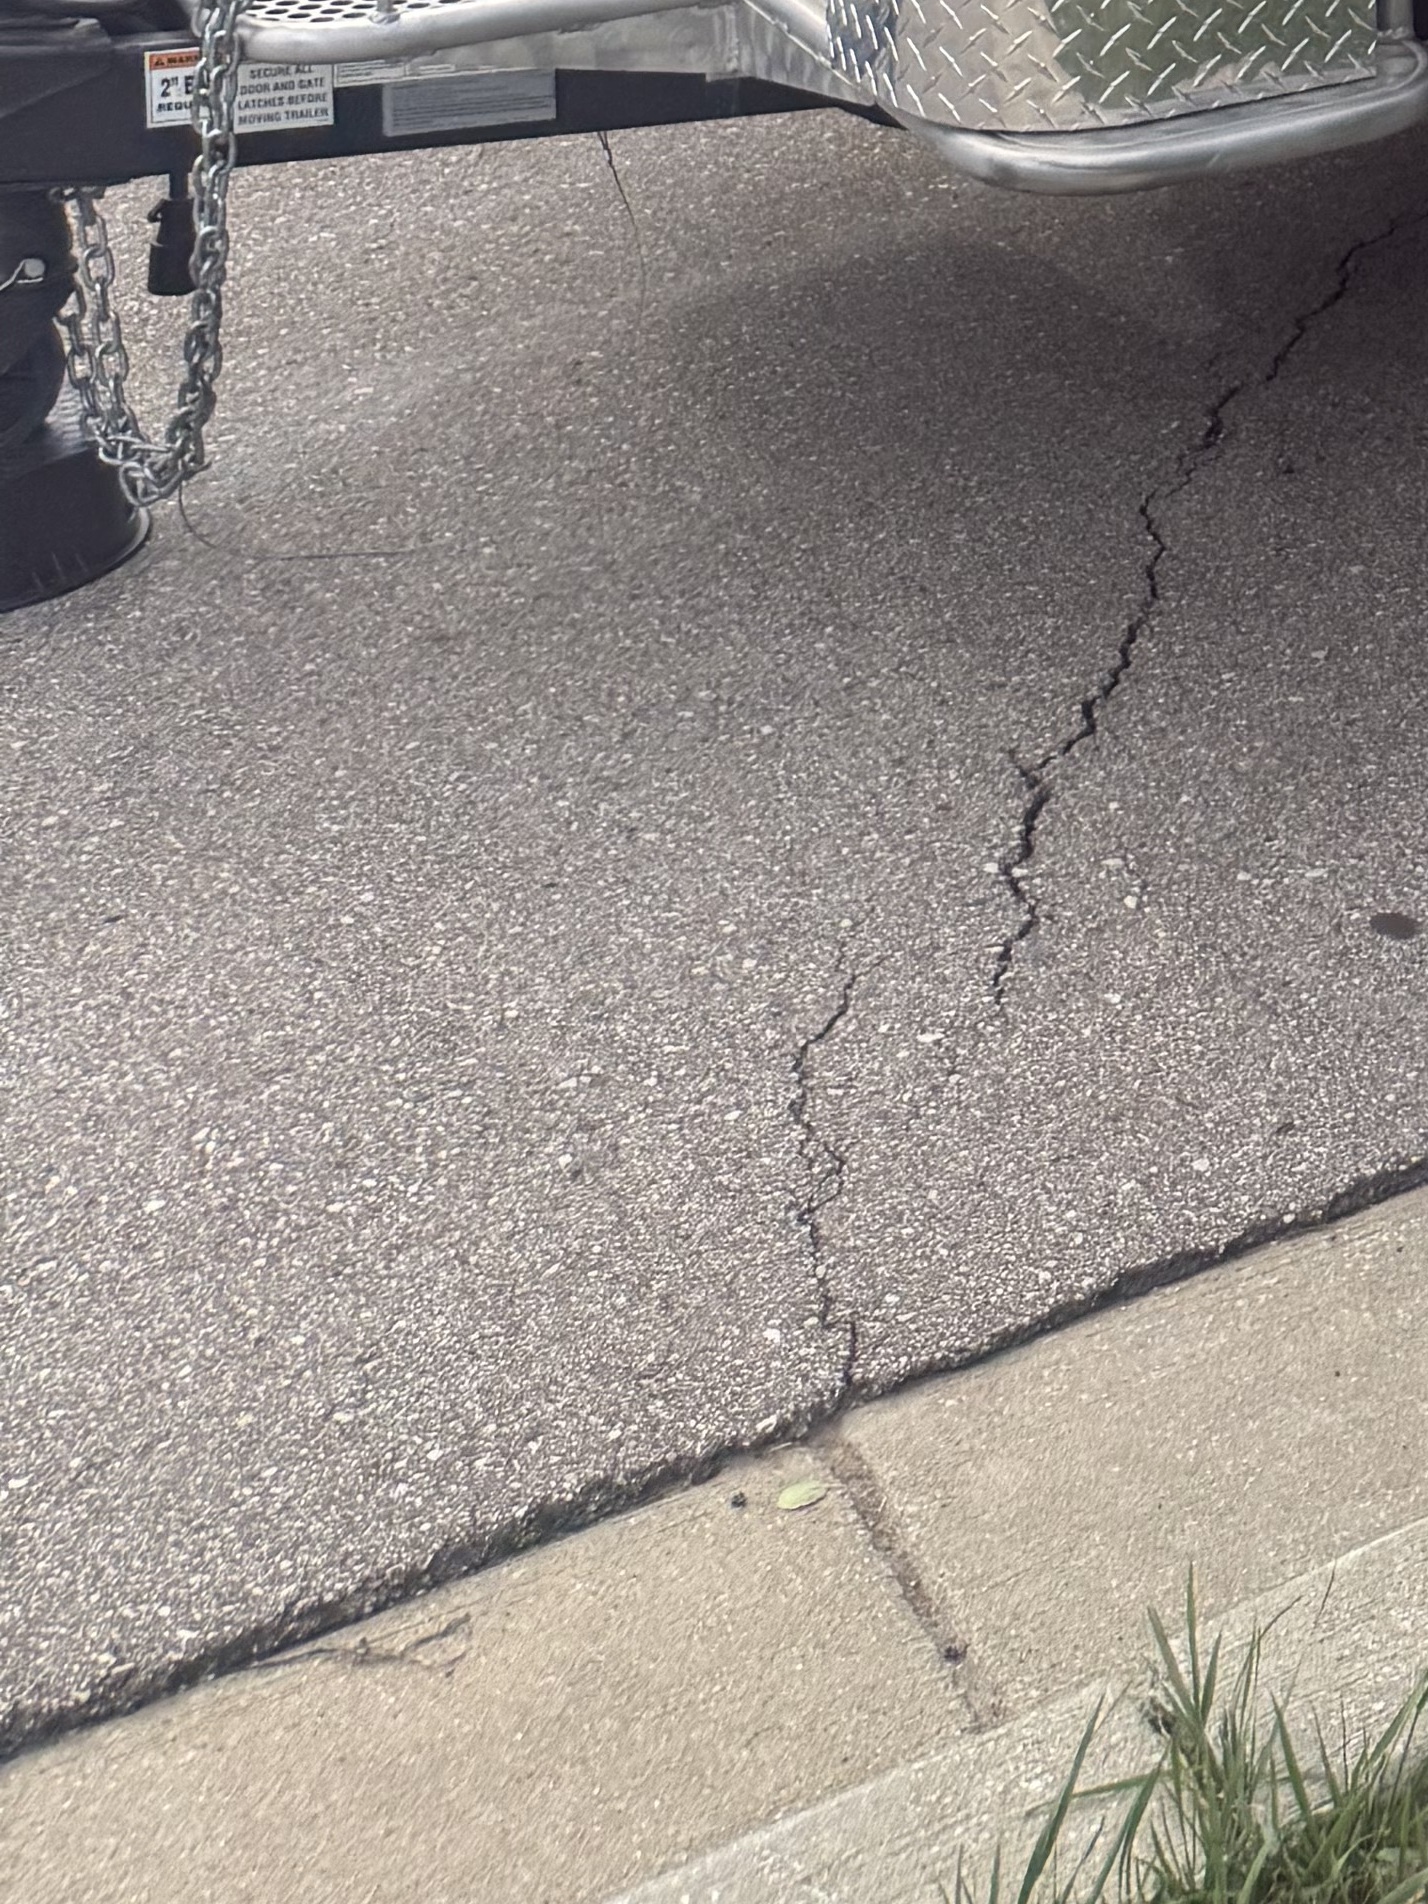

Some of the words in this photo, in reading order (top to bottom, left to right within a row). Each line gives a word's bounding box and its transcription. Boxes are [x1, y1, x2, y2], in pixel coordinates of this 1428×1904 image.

[250, 65, 292, 79] SECURE
[294, 64, 314, 74] ALL
[240, 83, 271, 96] DOOR
[273, 80, 295, 91] AND
[298, 77, 325, 89] GATE
[156, 101, 193, 113] REQU
[238, 95, 285, 110] LATCHES
[287, 92, 328, 105] BEFORE
[238, 112, 282, 126] MOVING
[285, 107, 329, 120] TRAILER
